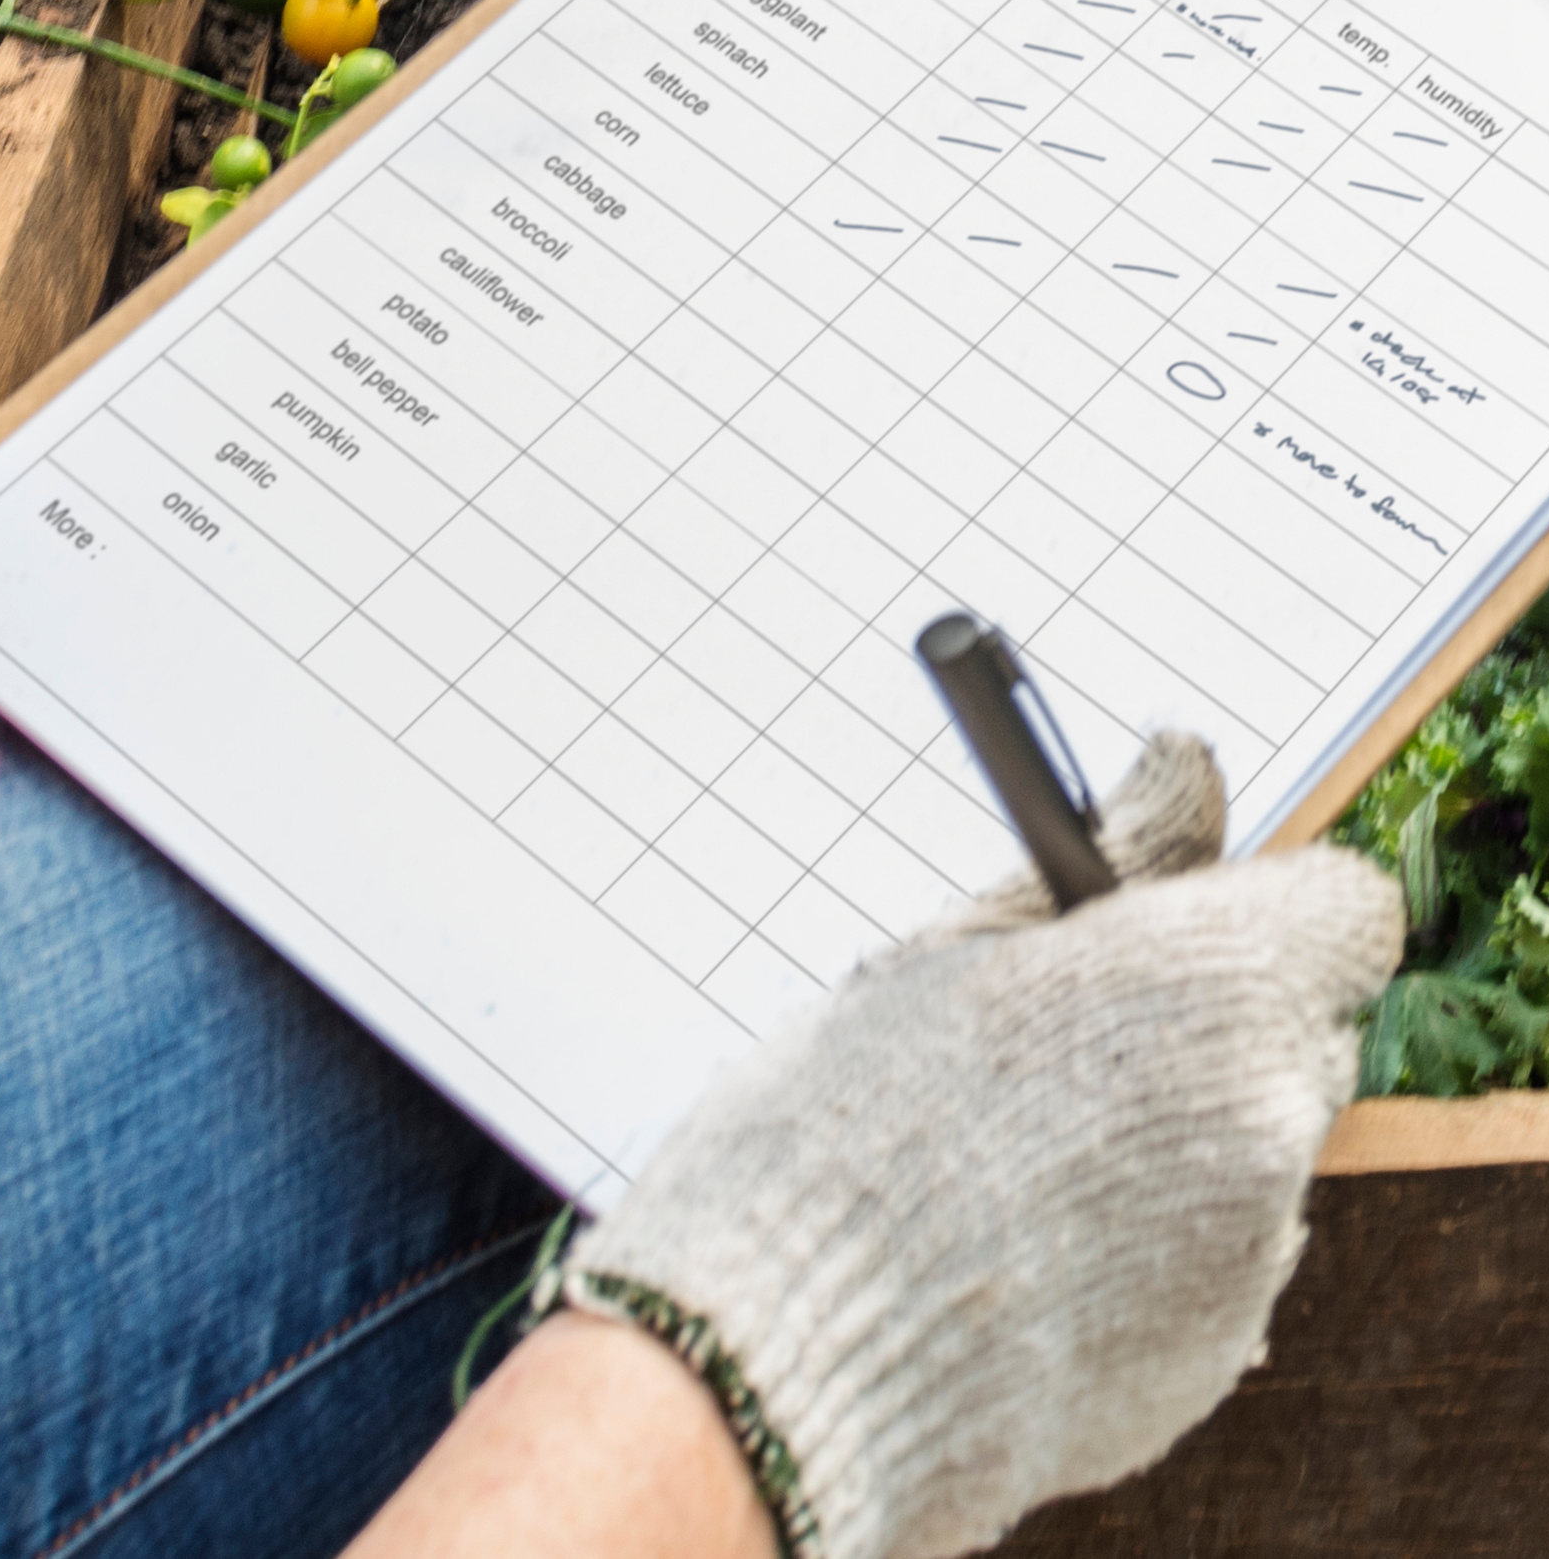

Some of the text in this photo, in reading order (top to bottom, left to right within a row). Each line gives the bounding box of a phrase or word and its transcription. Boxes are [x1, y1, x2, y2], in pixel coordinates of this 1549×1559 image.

[693, 19, 771, 80] spinach
[1337, 20, 1391, 69] temp.
[644, 62, 711, 118] lettuce
[1414, 73, 1505, 141] humidity
[594, 108, 641, 148] corn
[543, 153, 628, 221] cabbage
[491, 196, 573, 263] broccoli
[439, 245, 545, 330] cauliflower
[381, 292, 450, 348] potato
[330, 338, 440, 430] bell pepper
[271, 387, 362, 463] pumpkin
[214, 439, 278, 491] garlic
[161, 490, 223, 543] onion
